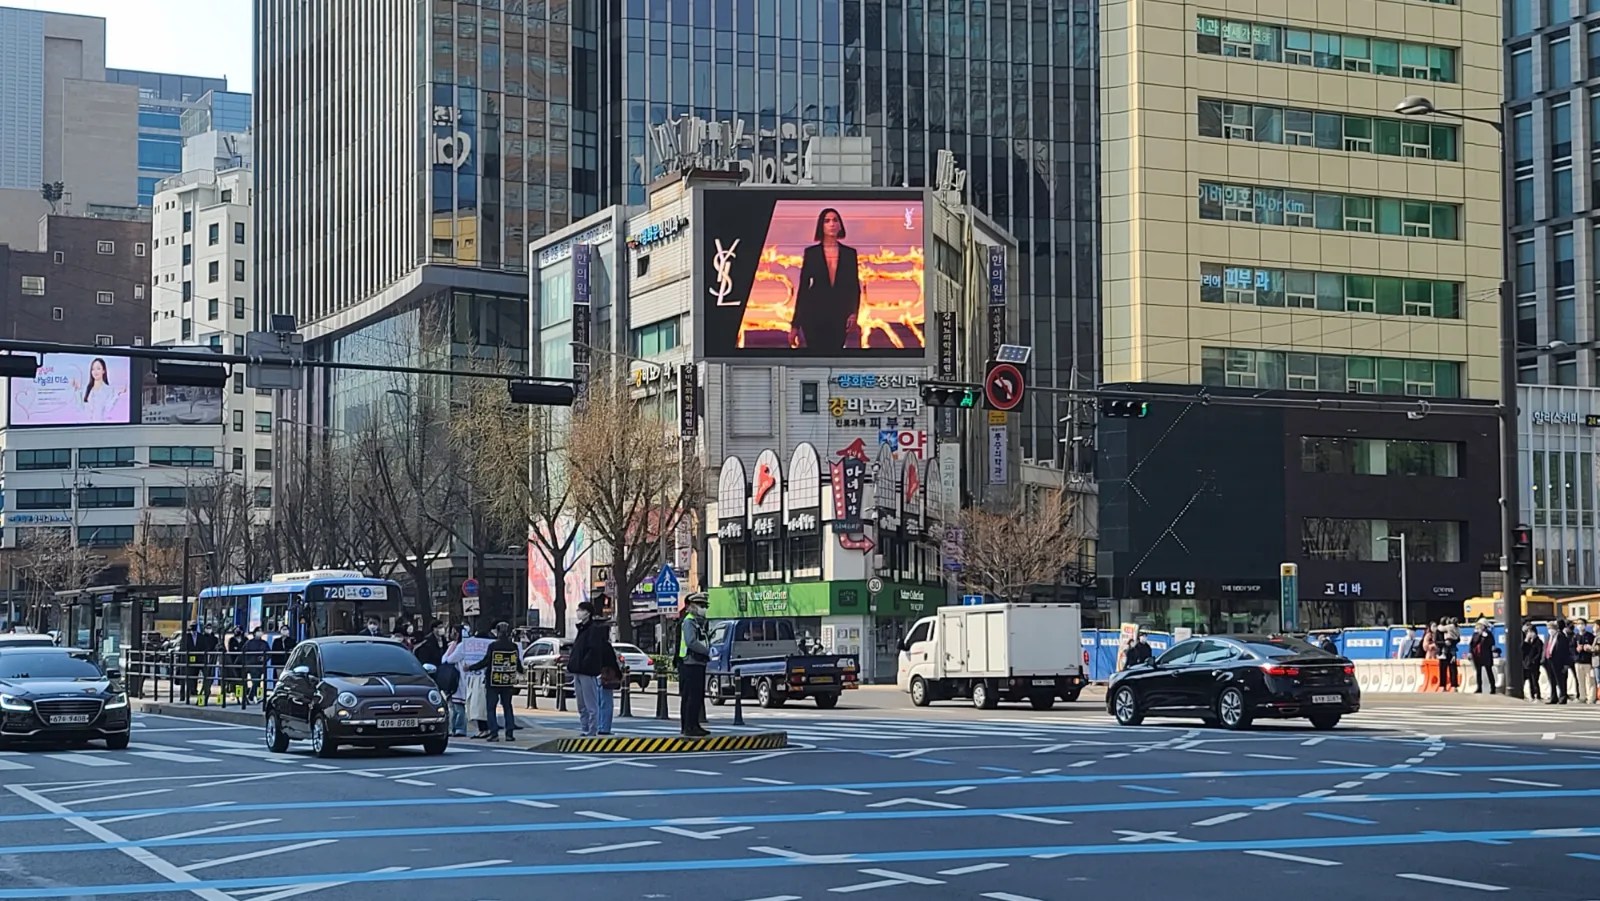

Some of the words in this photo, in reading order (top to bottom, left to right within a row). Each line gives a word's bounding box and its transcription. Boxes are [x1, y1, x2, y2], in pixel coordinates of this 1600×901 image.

[1199, 185, 1267, 210] 이비인후과
[709, 238, 741, 306] YSL
[1200, 275, 1221, 288] 리어
[1224, 267, 1269, 291] 피부과
[838, 374, 919, 388] 광화문정신과
[829, 397, 922, 416] 강비뇨기과
[870, 417, 916, 429] 피부과
[898, 431, 927, 460] 약
[846, 466, 863, 516] 마녀김밥
[324, 587, 344, 599] 720
[870, 580, 880, 590] 30
[1141, 581, 1195, 595] 더바디샵
[1324, 583, 1361, 596] 고디바
